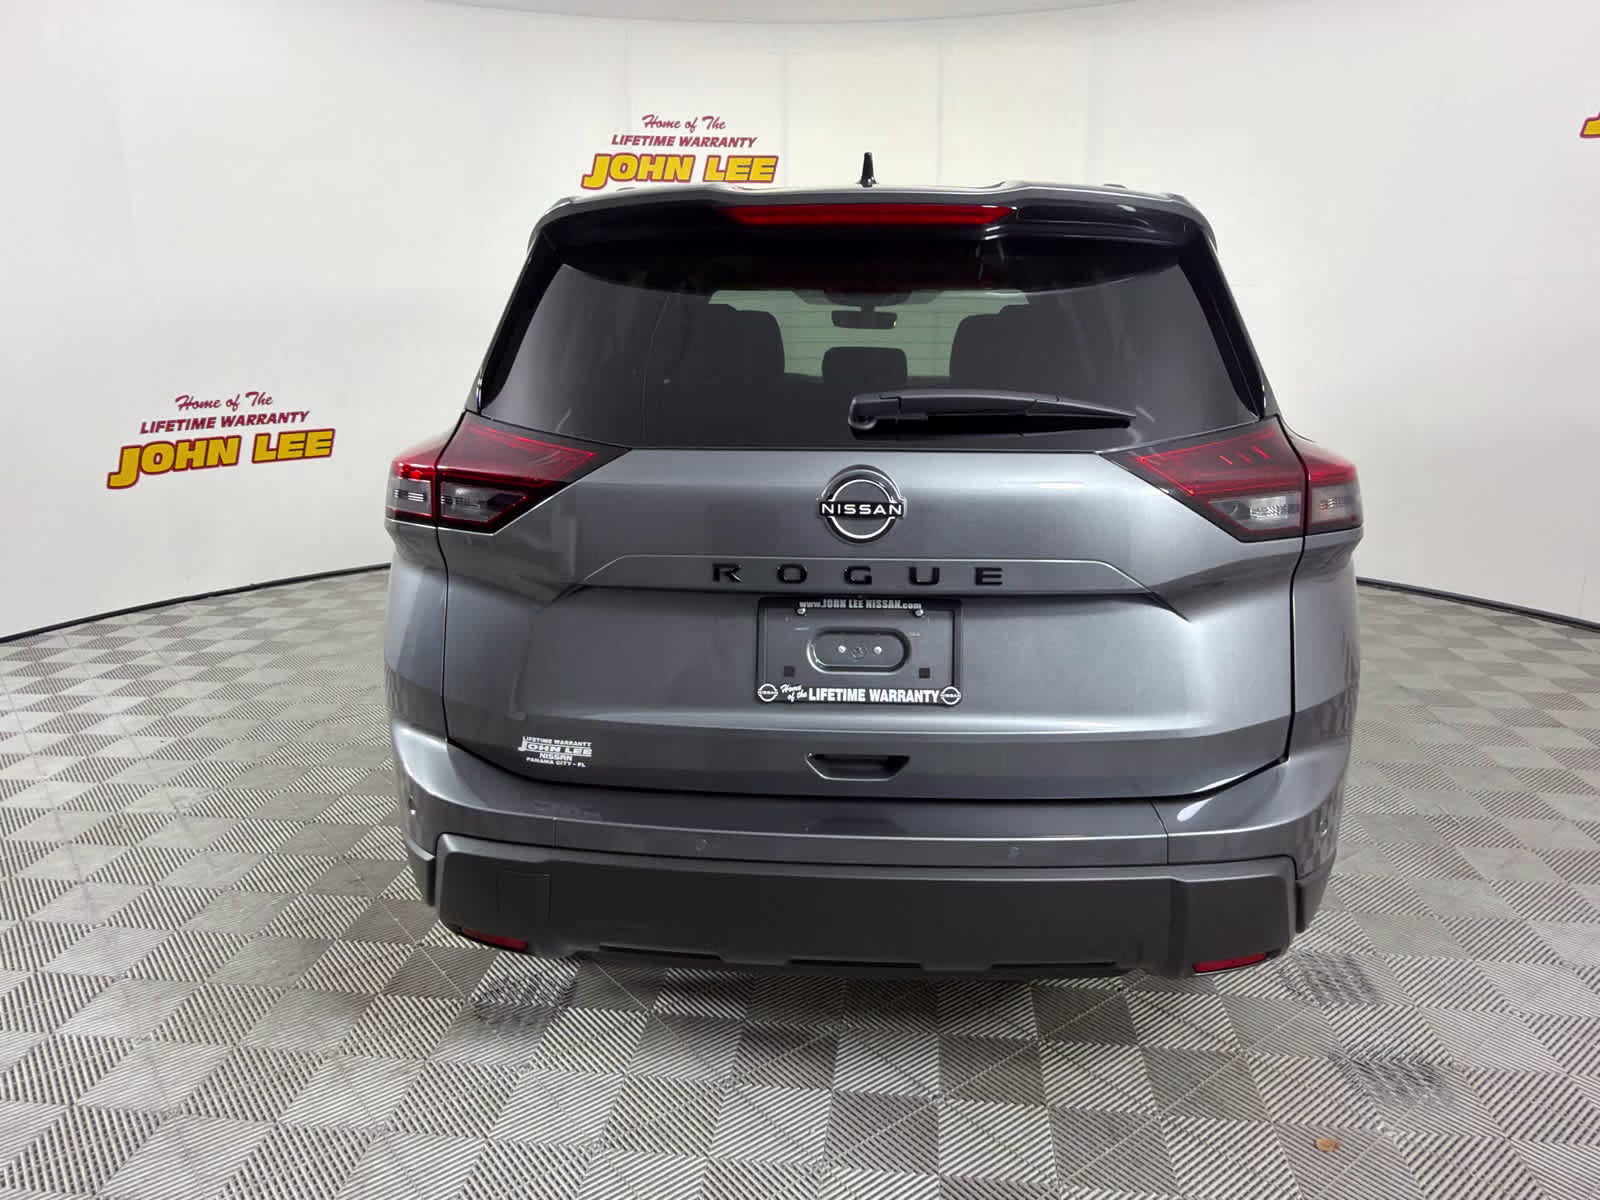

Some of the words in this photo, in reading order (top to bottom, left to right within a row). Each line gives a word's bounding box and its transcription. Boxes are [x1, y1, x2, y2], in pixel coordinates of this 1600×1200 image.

[642, 114, 680, 129] Home
[685, 117, 698, 133] of
[702, 116, 727, 130] The
[611, 134, 675, 147] LIFETIME
[679, 136, 757, 148] WARRANTY
[581, 153, 696, 190] JOHN
[703, 155, 779, 183] LEE
[175, 394, 221, 411] Home
[225, 394, 240, 411] of
[245, 391, 273, 408] The
[140, 417, 216, 434] LIFETIME
[221, 410, 310, 429] WARRANTY
[107, 435, 242, 490] JOHN
[252, 428, 336, 464] LEE
[821, 503, 903, 516] NISSAN
[712, 563, 1003, 585] ROGUE
[848, 599, 865, 609] LEE
[808, 687, 866, 702] LIFETIME
[869, 688, 940, 704] WARRANTY
[518, 740, 561, 753] JOHN
[564, 746, 593, 757] LEE
[539, 752, 573, 761] NISSAN
